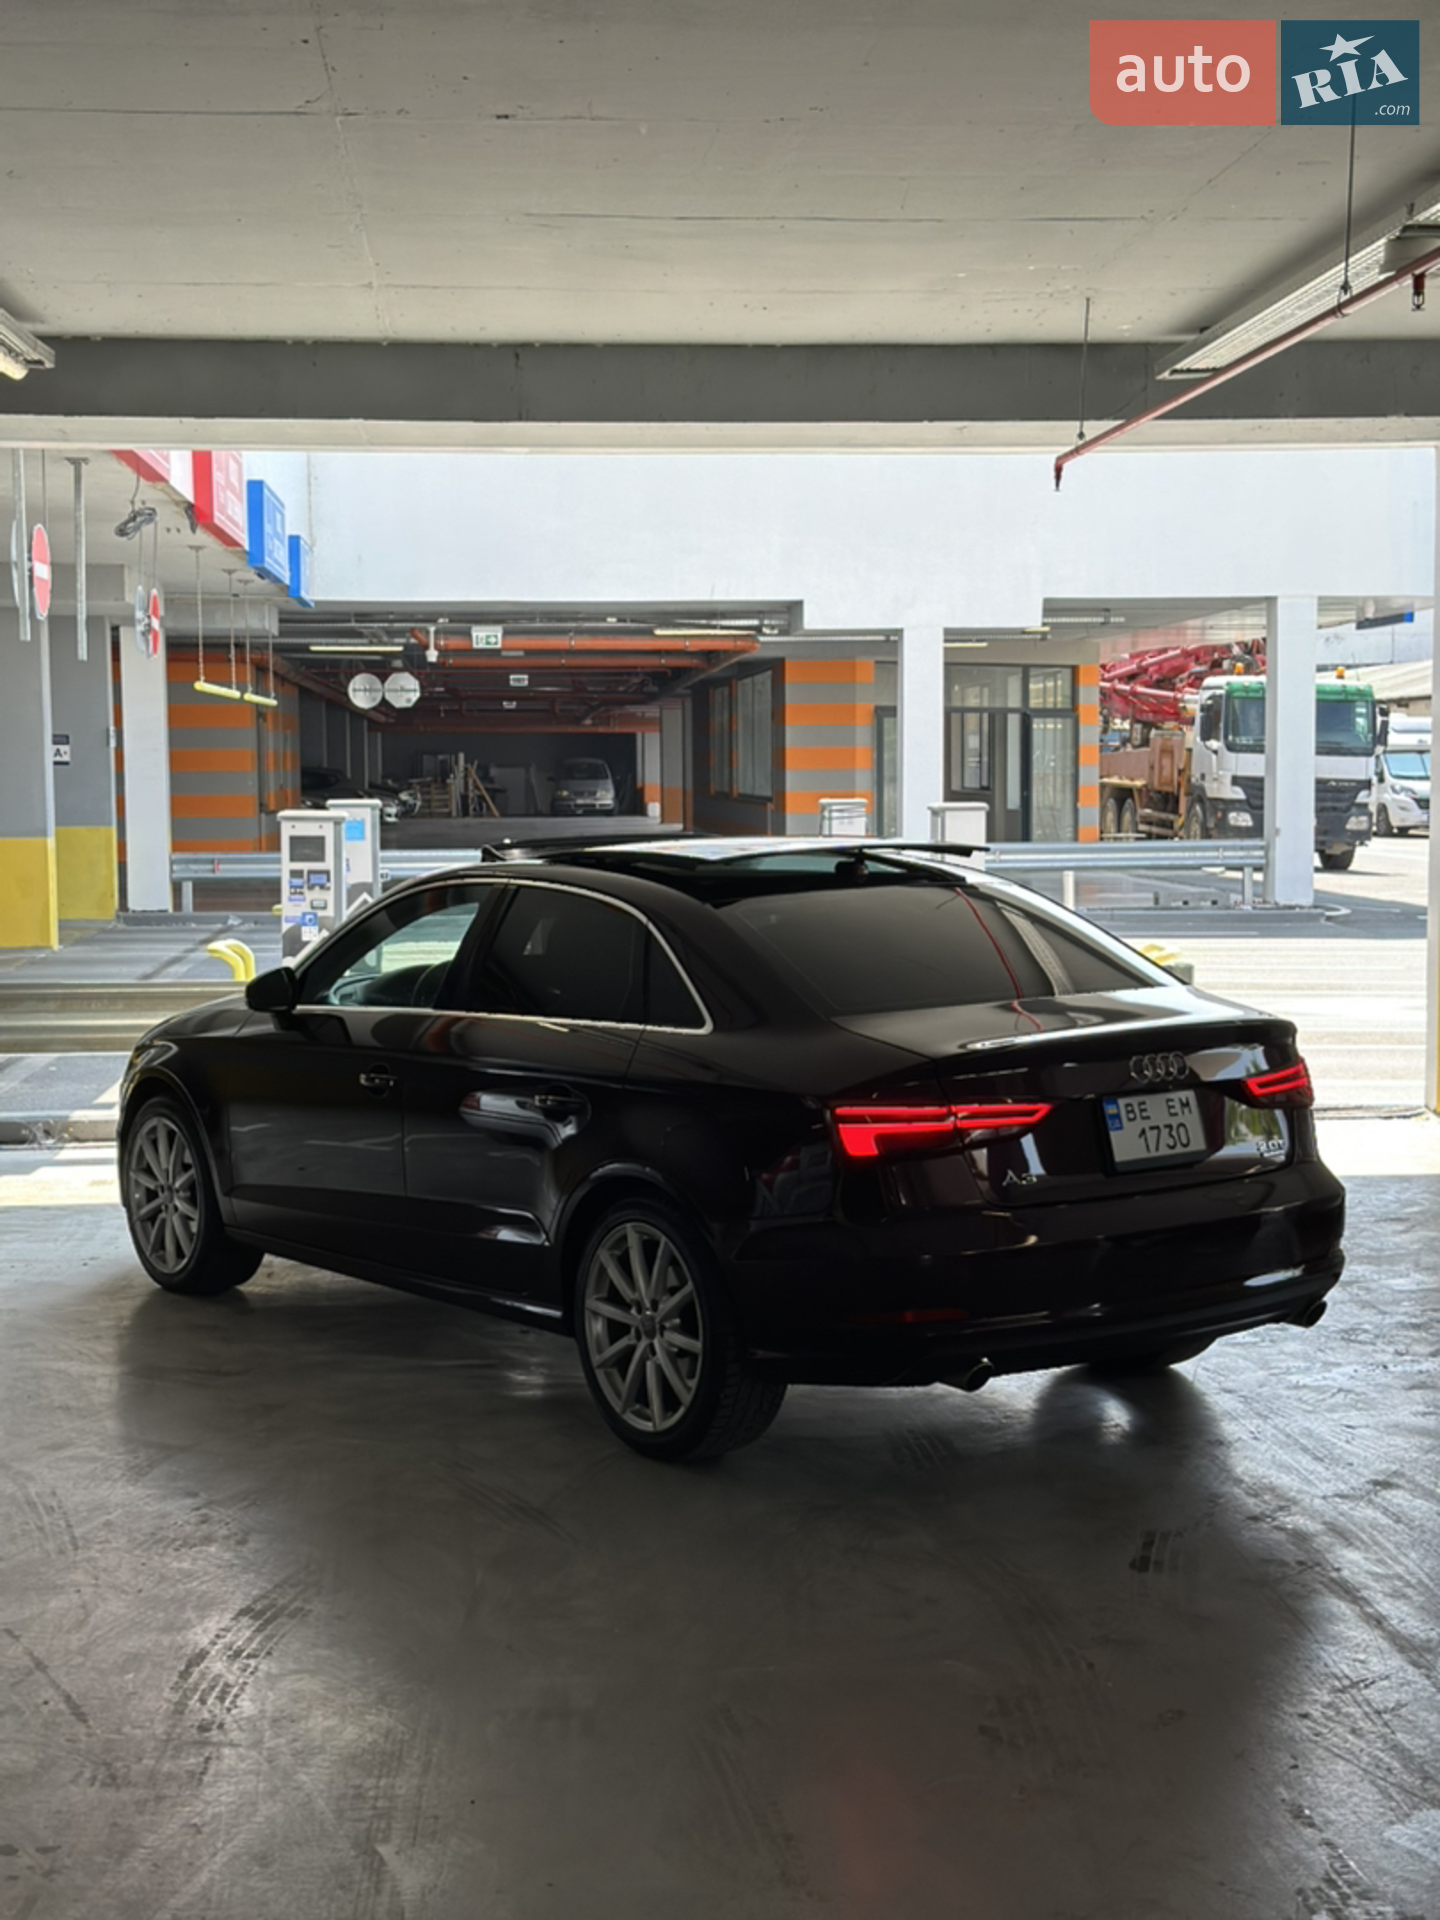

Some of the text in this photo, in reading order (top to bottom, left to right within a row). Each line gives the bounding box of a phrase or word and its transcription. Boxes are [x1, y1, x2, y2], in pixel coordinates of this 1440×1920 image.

[1124, 1096, 1193, 1122] BE EM
[1138, 1122, 1191, 1154] 1730
